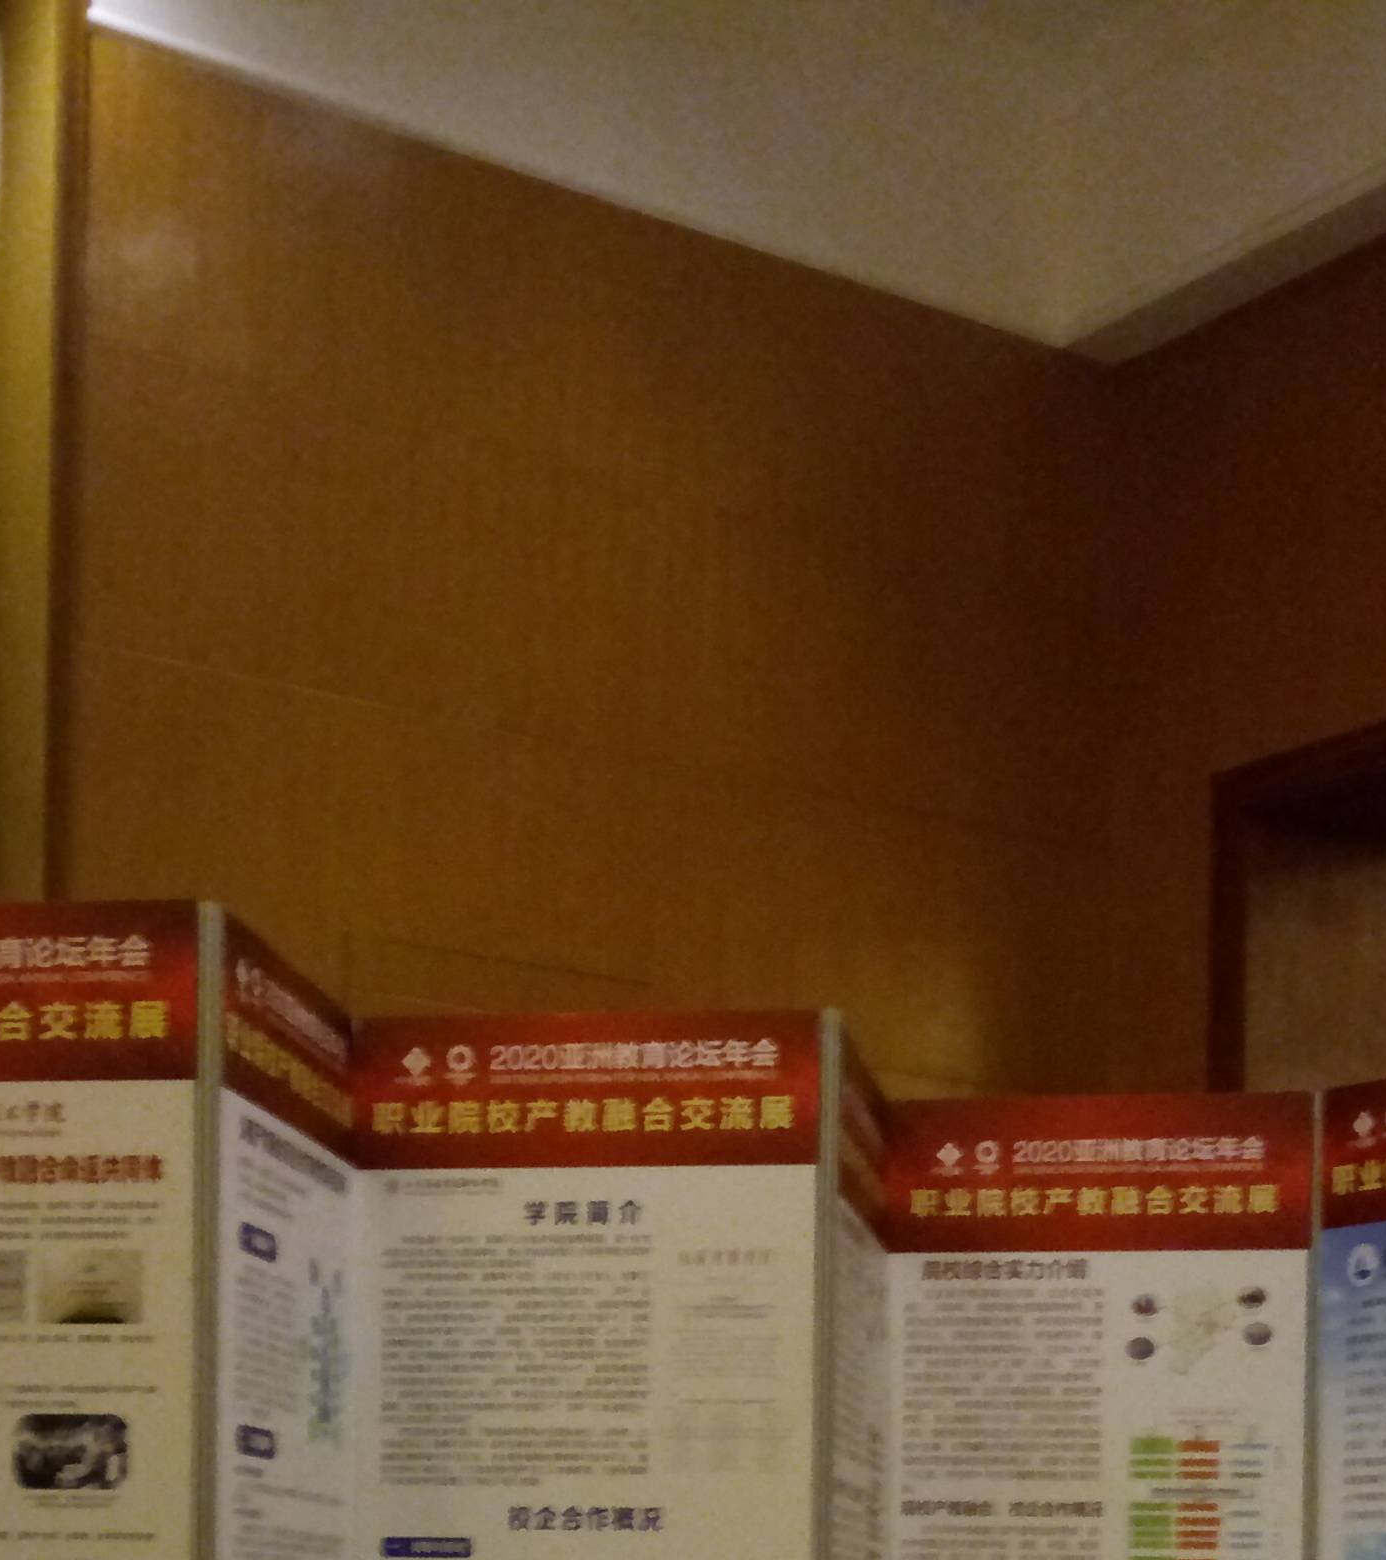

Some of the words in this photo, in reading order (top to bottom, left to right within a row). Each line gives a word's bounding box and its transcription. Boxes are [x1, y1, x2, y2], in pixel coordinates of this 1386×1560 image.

[372, 1095, 796, 1134] 职业院校产教融合交流展
[910, 1184, 1278, 1217] 职业院校产教融合交流展
